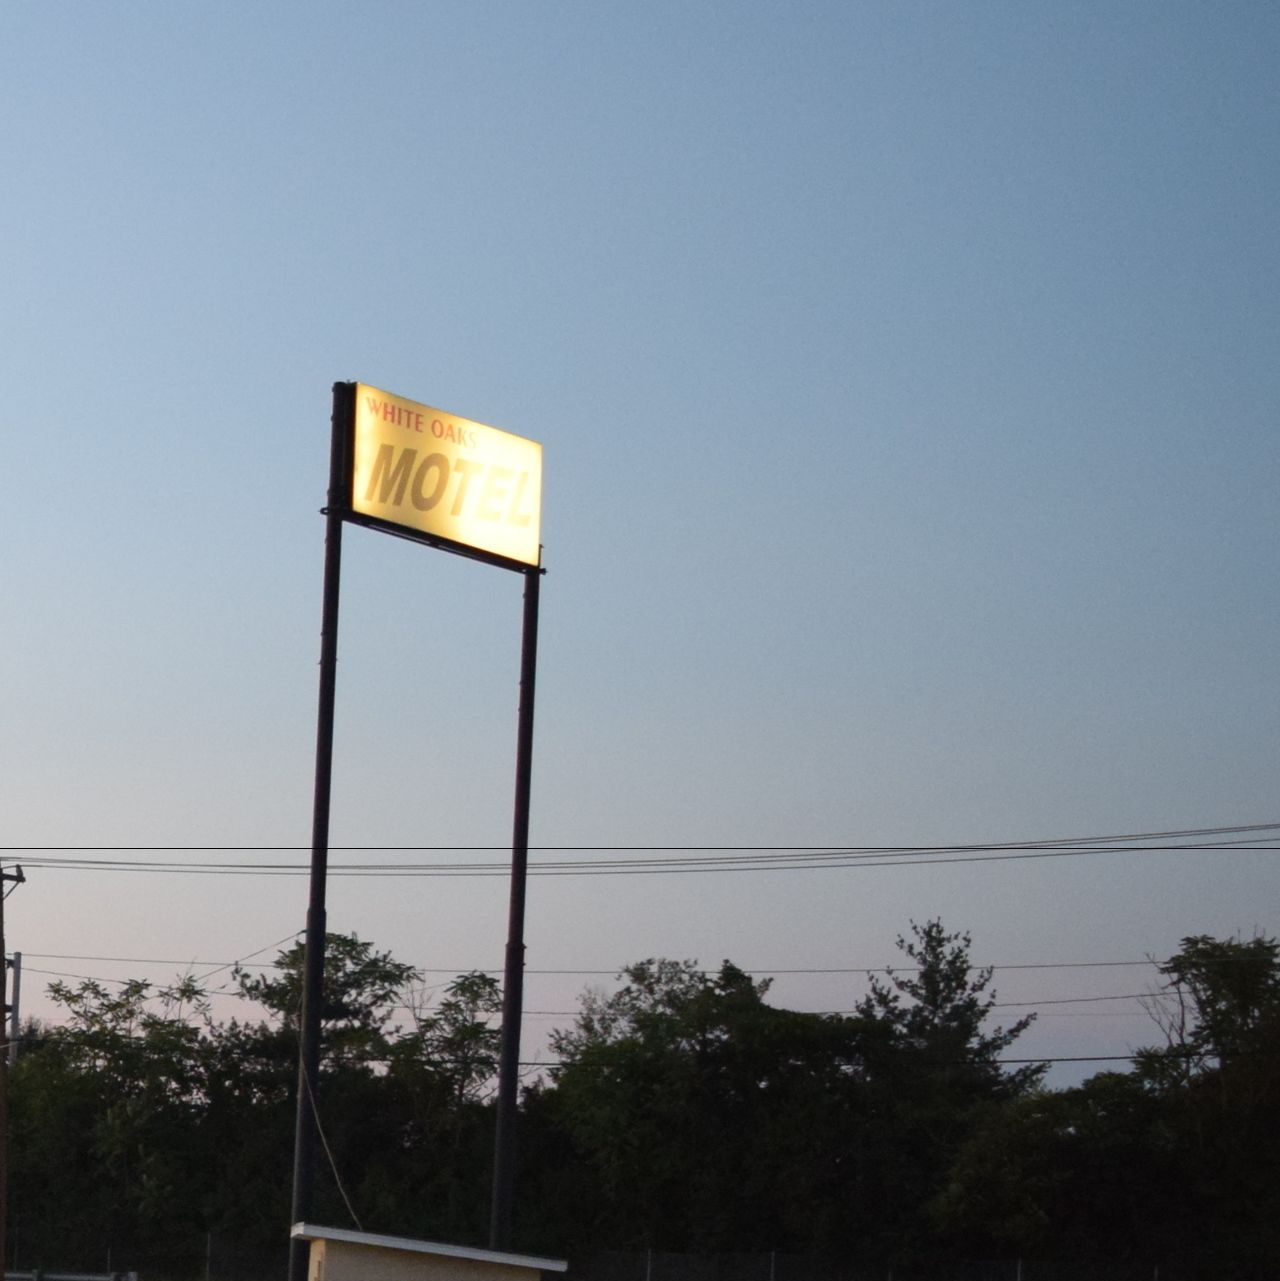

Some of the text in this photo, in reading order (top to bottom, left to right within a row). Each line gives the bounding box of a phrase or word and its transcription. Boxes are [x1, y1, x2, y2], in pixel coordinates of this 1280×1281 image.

[366, 396, 477, 449] WHITE OAKS
[364, 443, 532, 527] MOTEL
